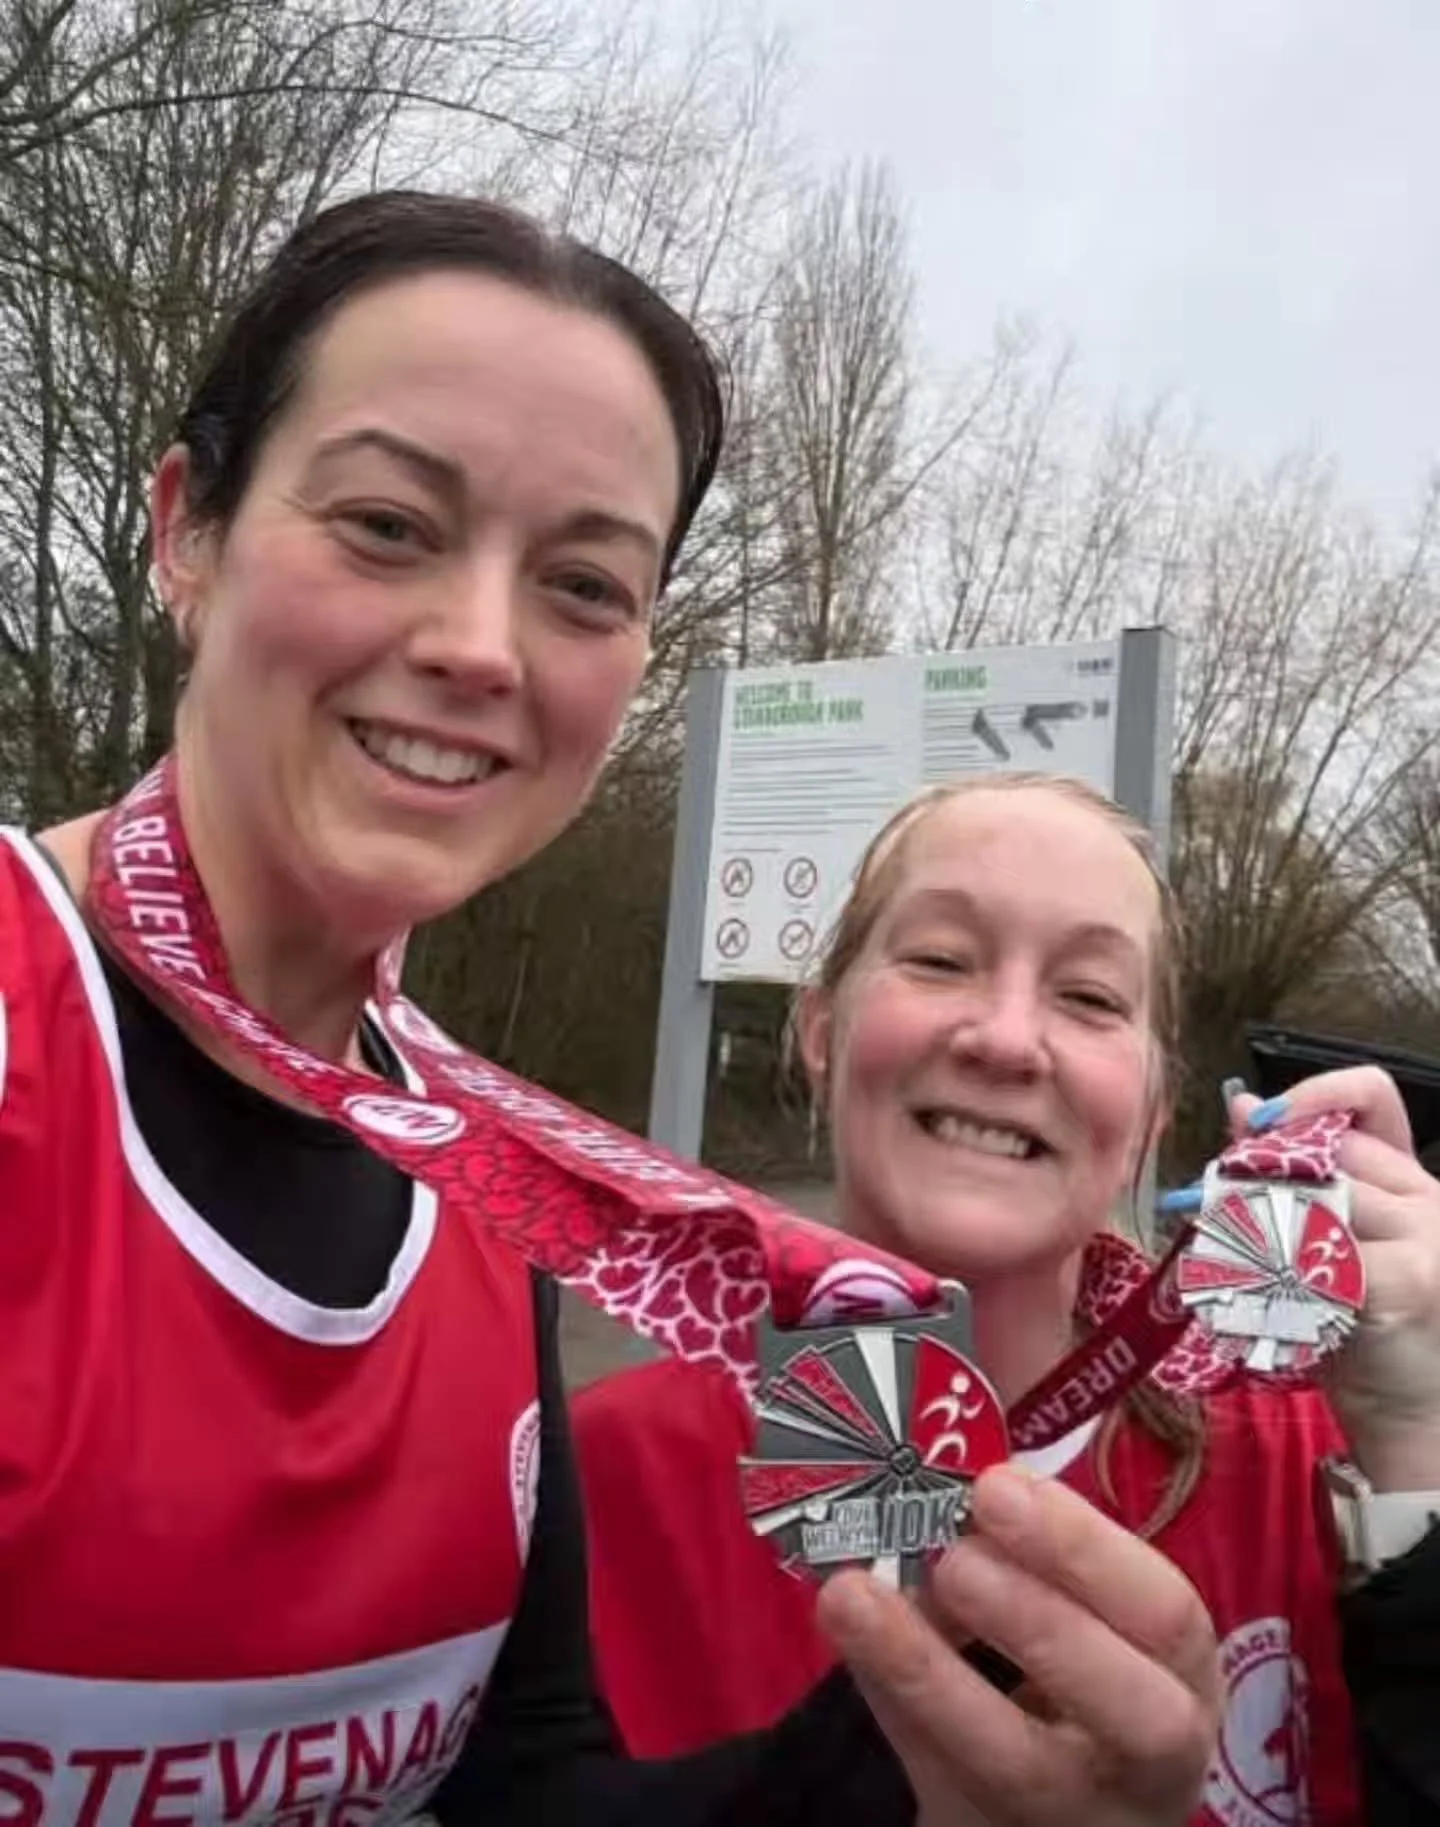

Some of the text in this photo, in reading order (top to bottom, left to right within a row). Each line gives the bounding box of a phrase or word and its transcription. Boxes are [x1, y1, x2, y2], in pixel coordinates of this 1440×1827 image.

[735, 680, 813, 706] WELCOME TO
[924, 666, 987, 691] PARKING
[829, 697, 864, 723] PARK
[111, 815, 207, 981] BELIEVE
[1013, 1335, 1137, 1444] DREAM
[882, 1489, 960, 1554] 10K
